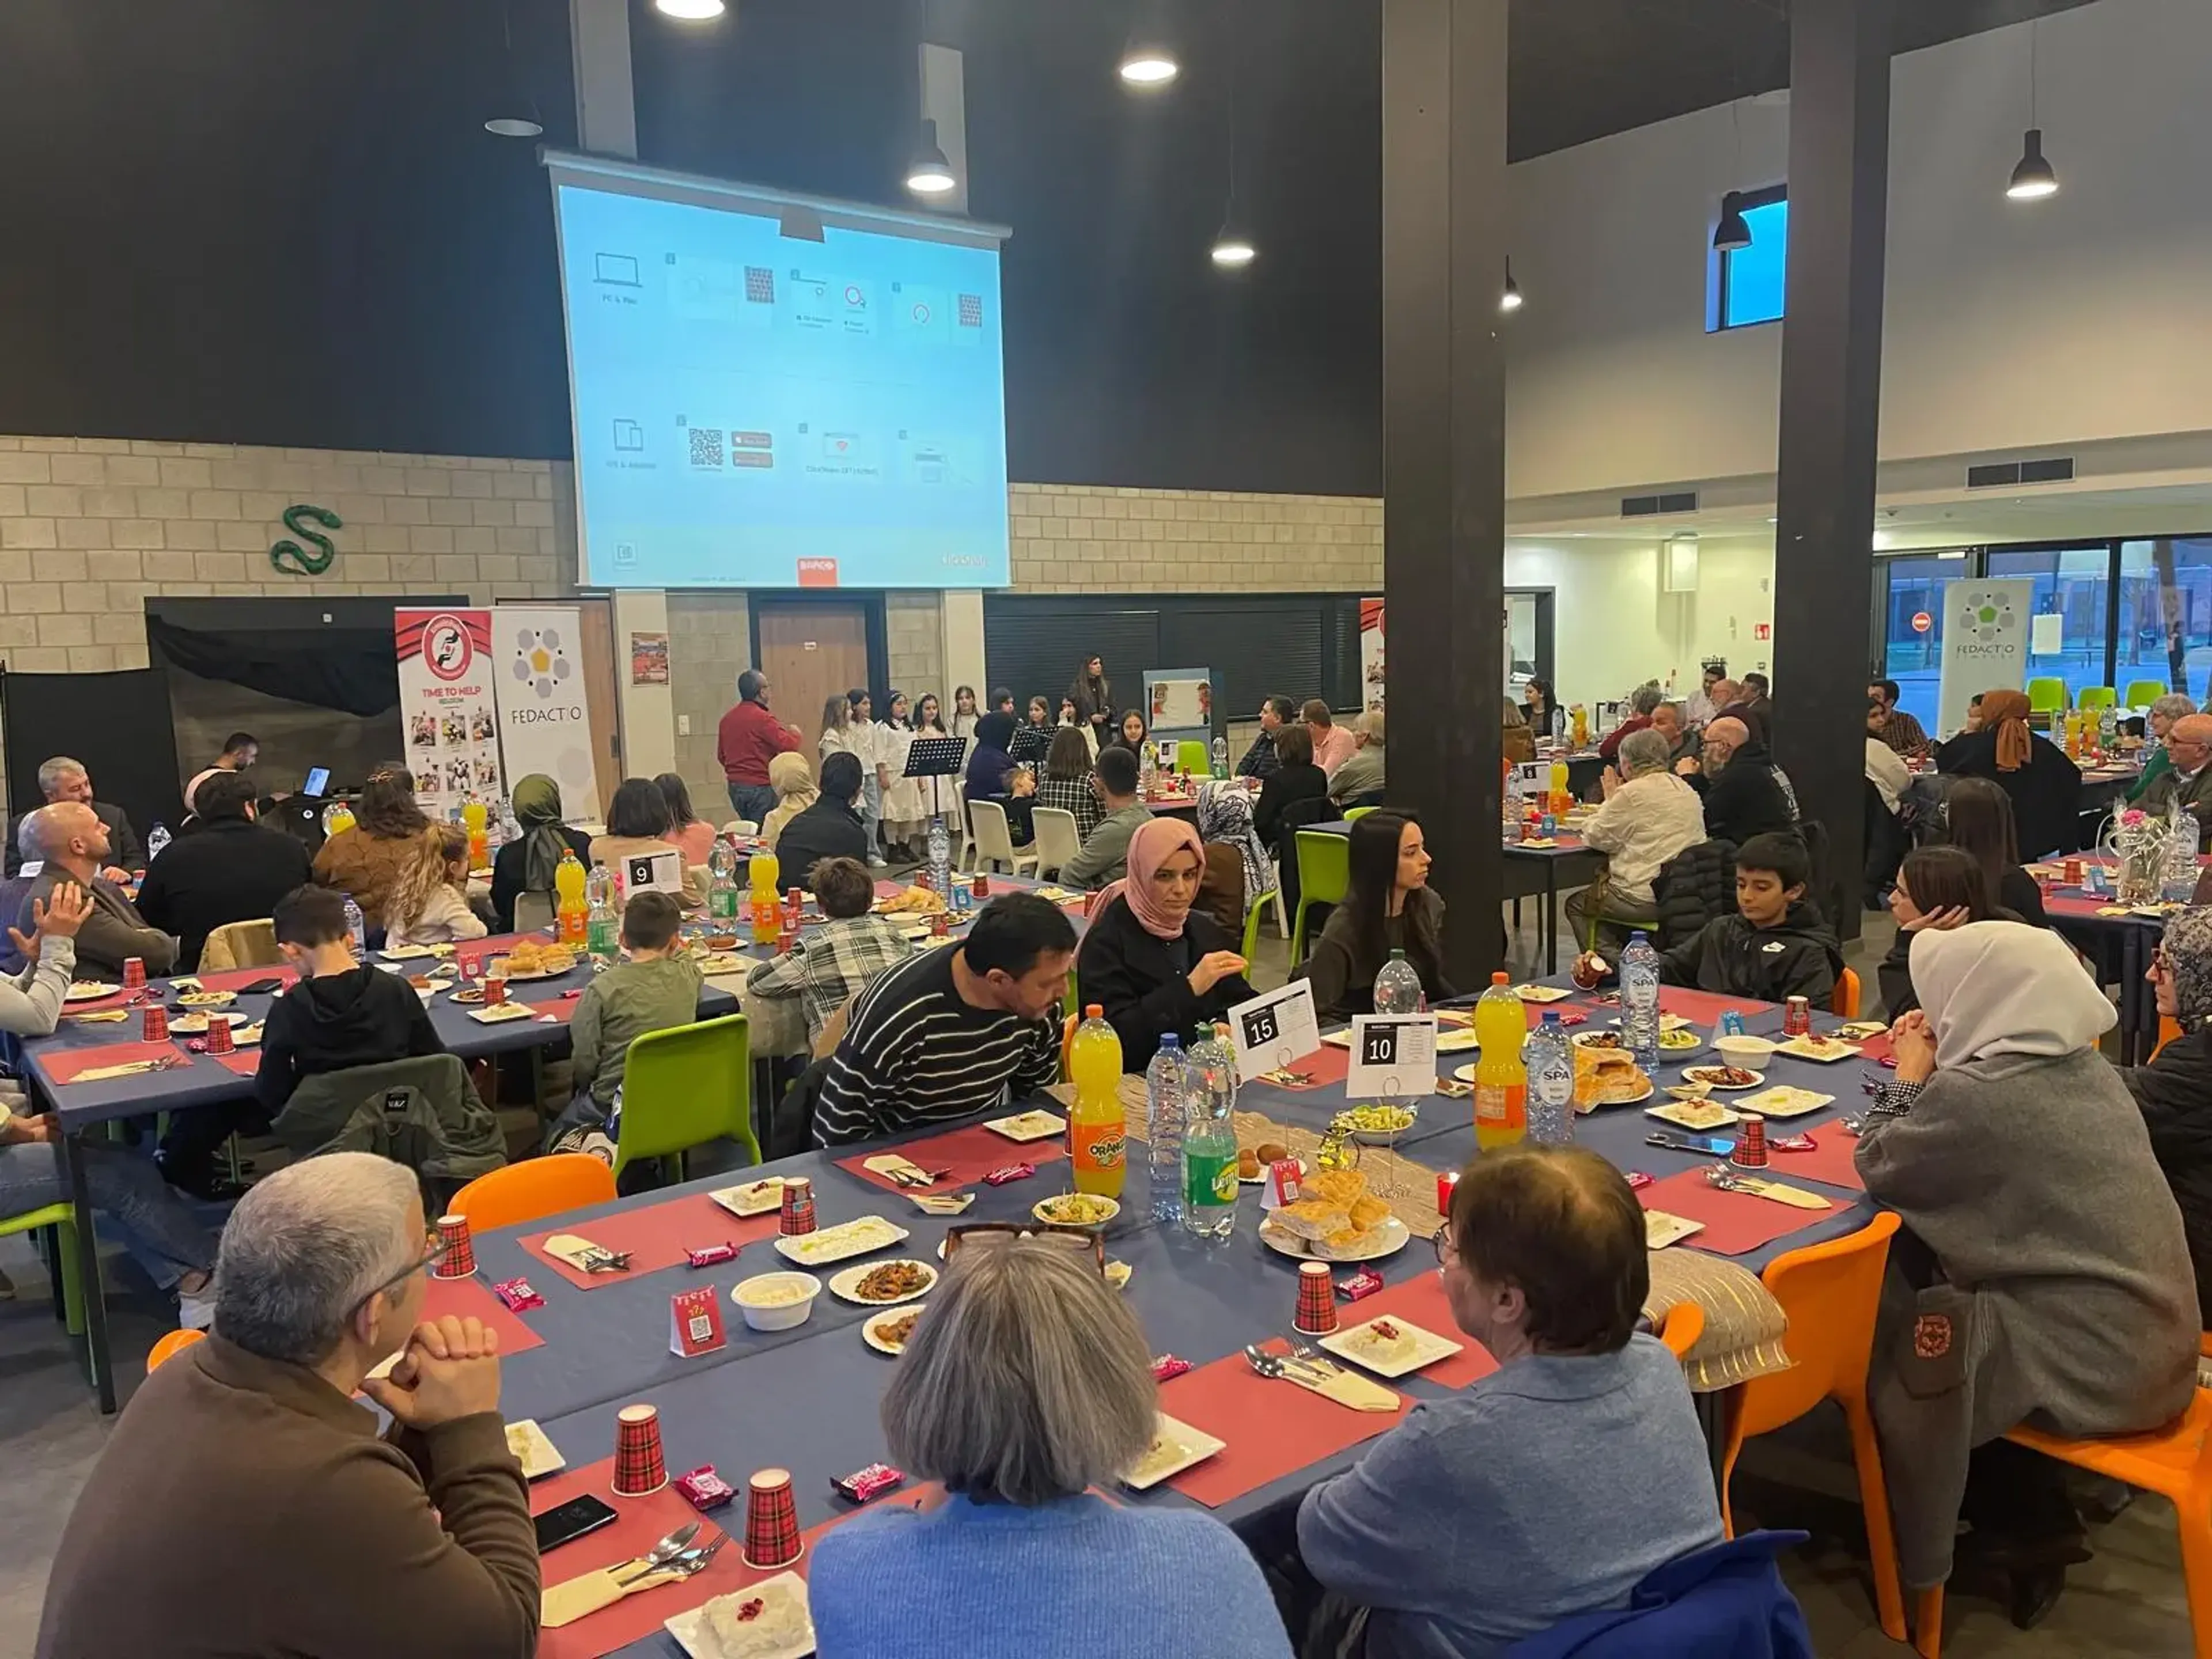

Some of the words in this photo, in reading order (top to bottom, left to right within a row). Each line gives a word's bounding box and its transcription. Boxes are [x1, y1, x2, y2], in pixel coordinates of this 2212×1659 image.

[422, 688, 444, 698] TIME
[445, 687, 457, 696] TO
[459, 685, 482, 696] HELP
[636, 866, 647, 882] 9
[1631, 979, 1654, 987] SPA
[1251, 1018, 1272, 1044] 15
[1369, 1039, 1391, 1060] 10
[1543, 1071, 1570, 1081] SPA
